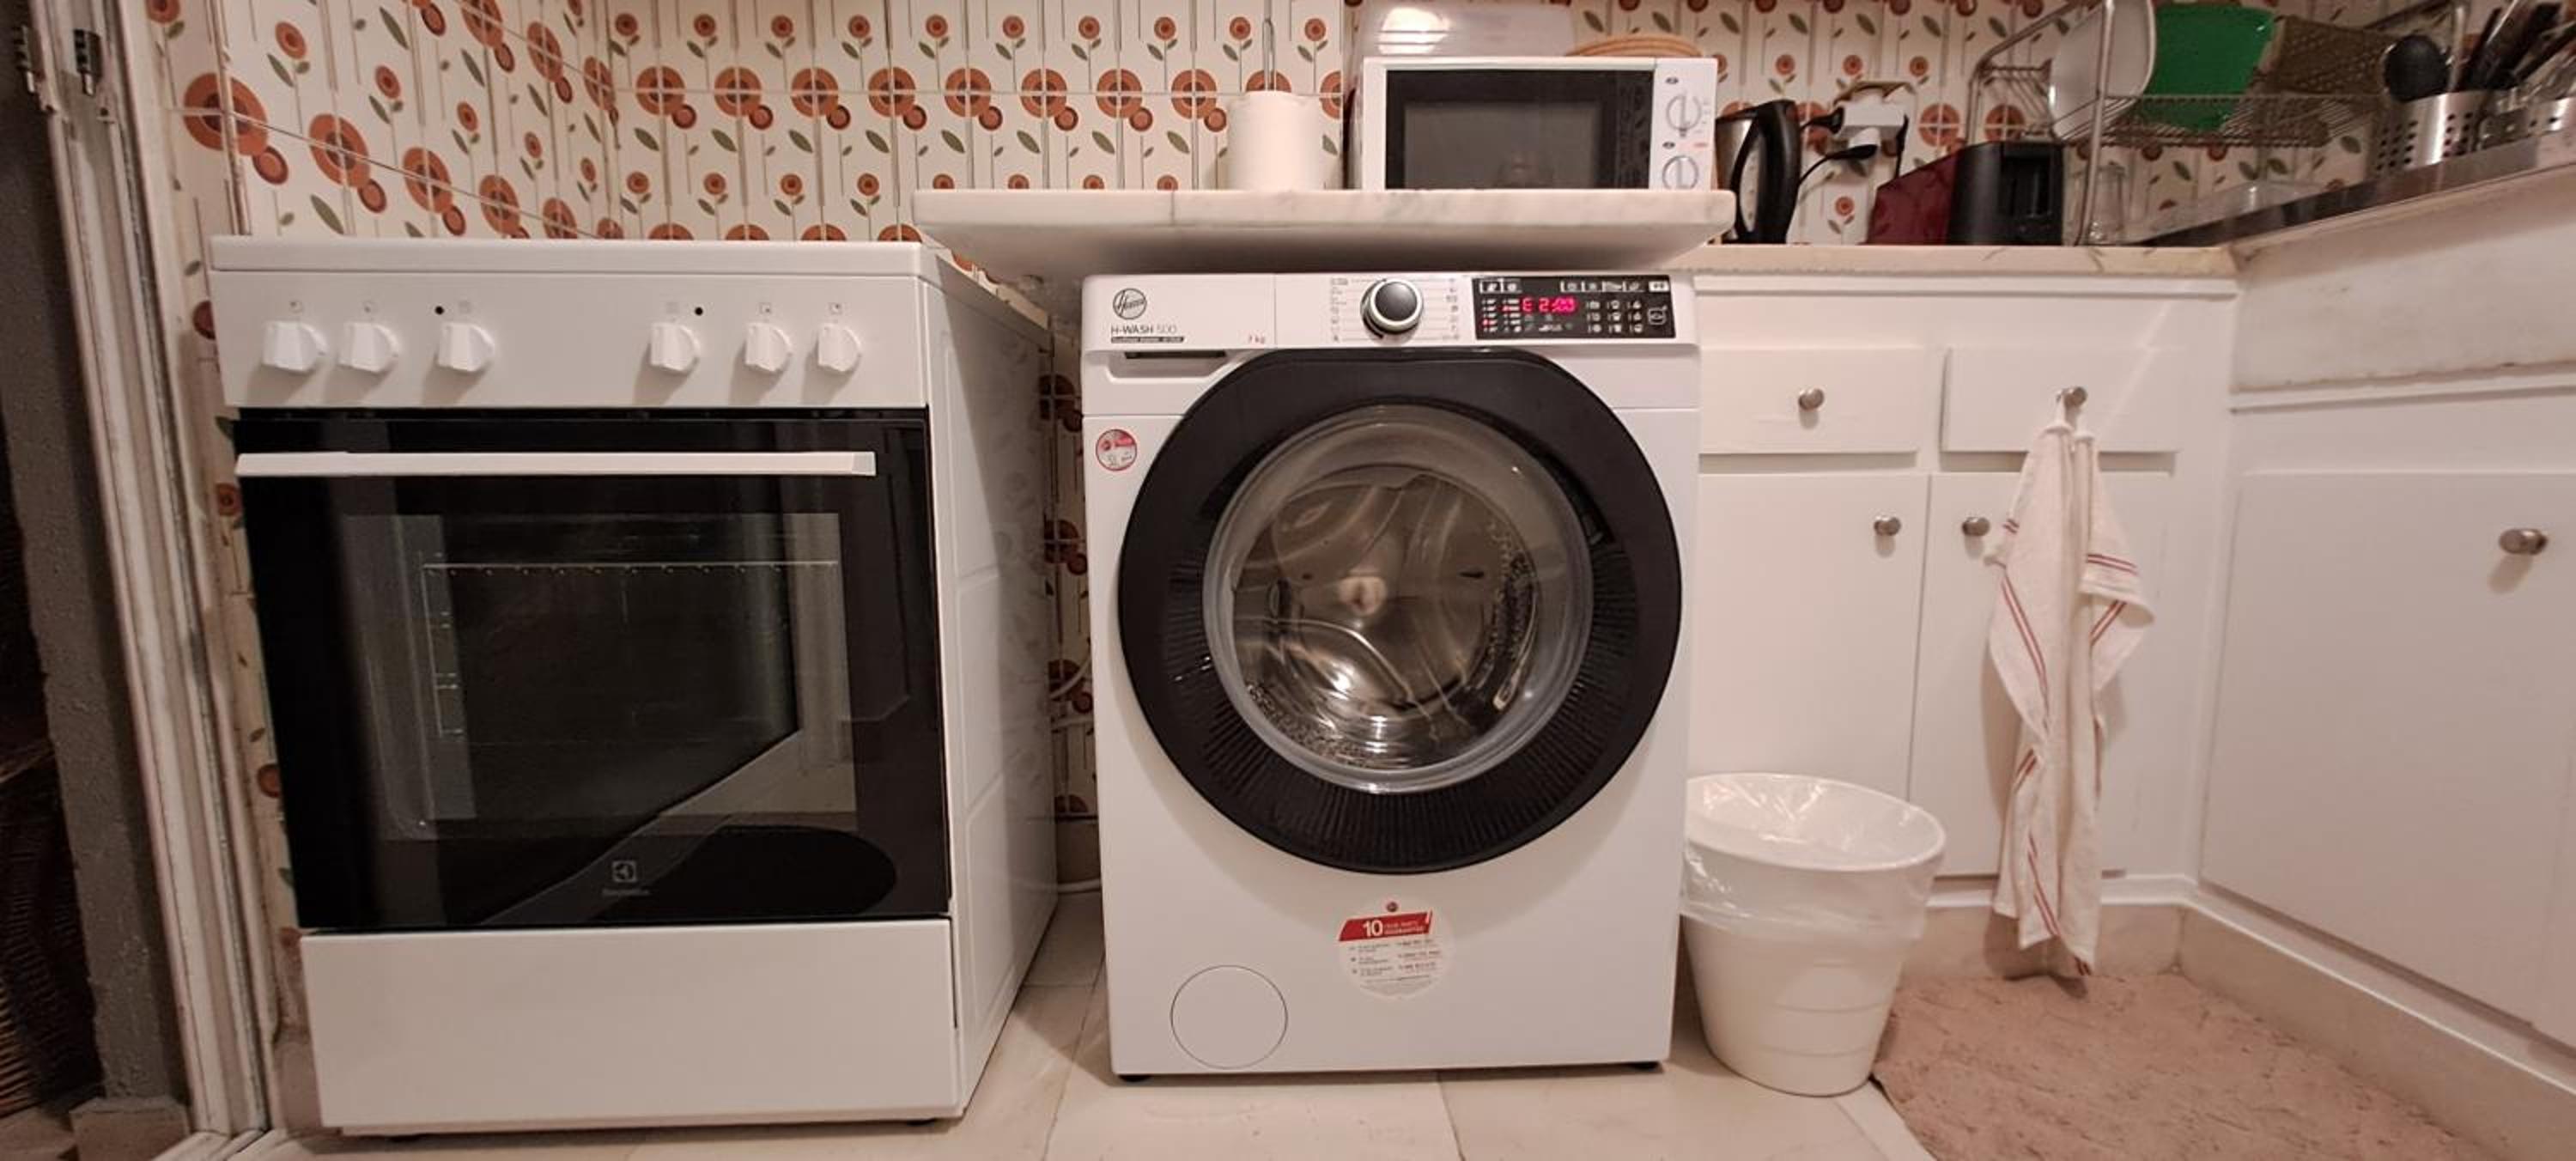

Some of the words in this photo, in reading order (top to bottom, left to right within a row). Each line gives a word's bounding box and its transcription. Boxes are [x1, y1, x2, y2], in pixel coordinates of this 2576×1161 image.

[1111, 325, 1153, 334] H-WASH
[1157, 325, 1177, 333] 500
[1363, 920, 1383, 937] 10
